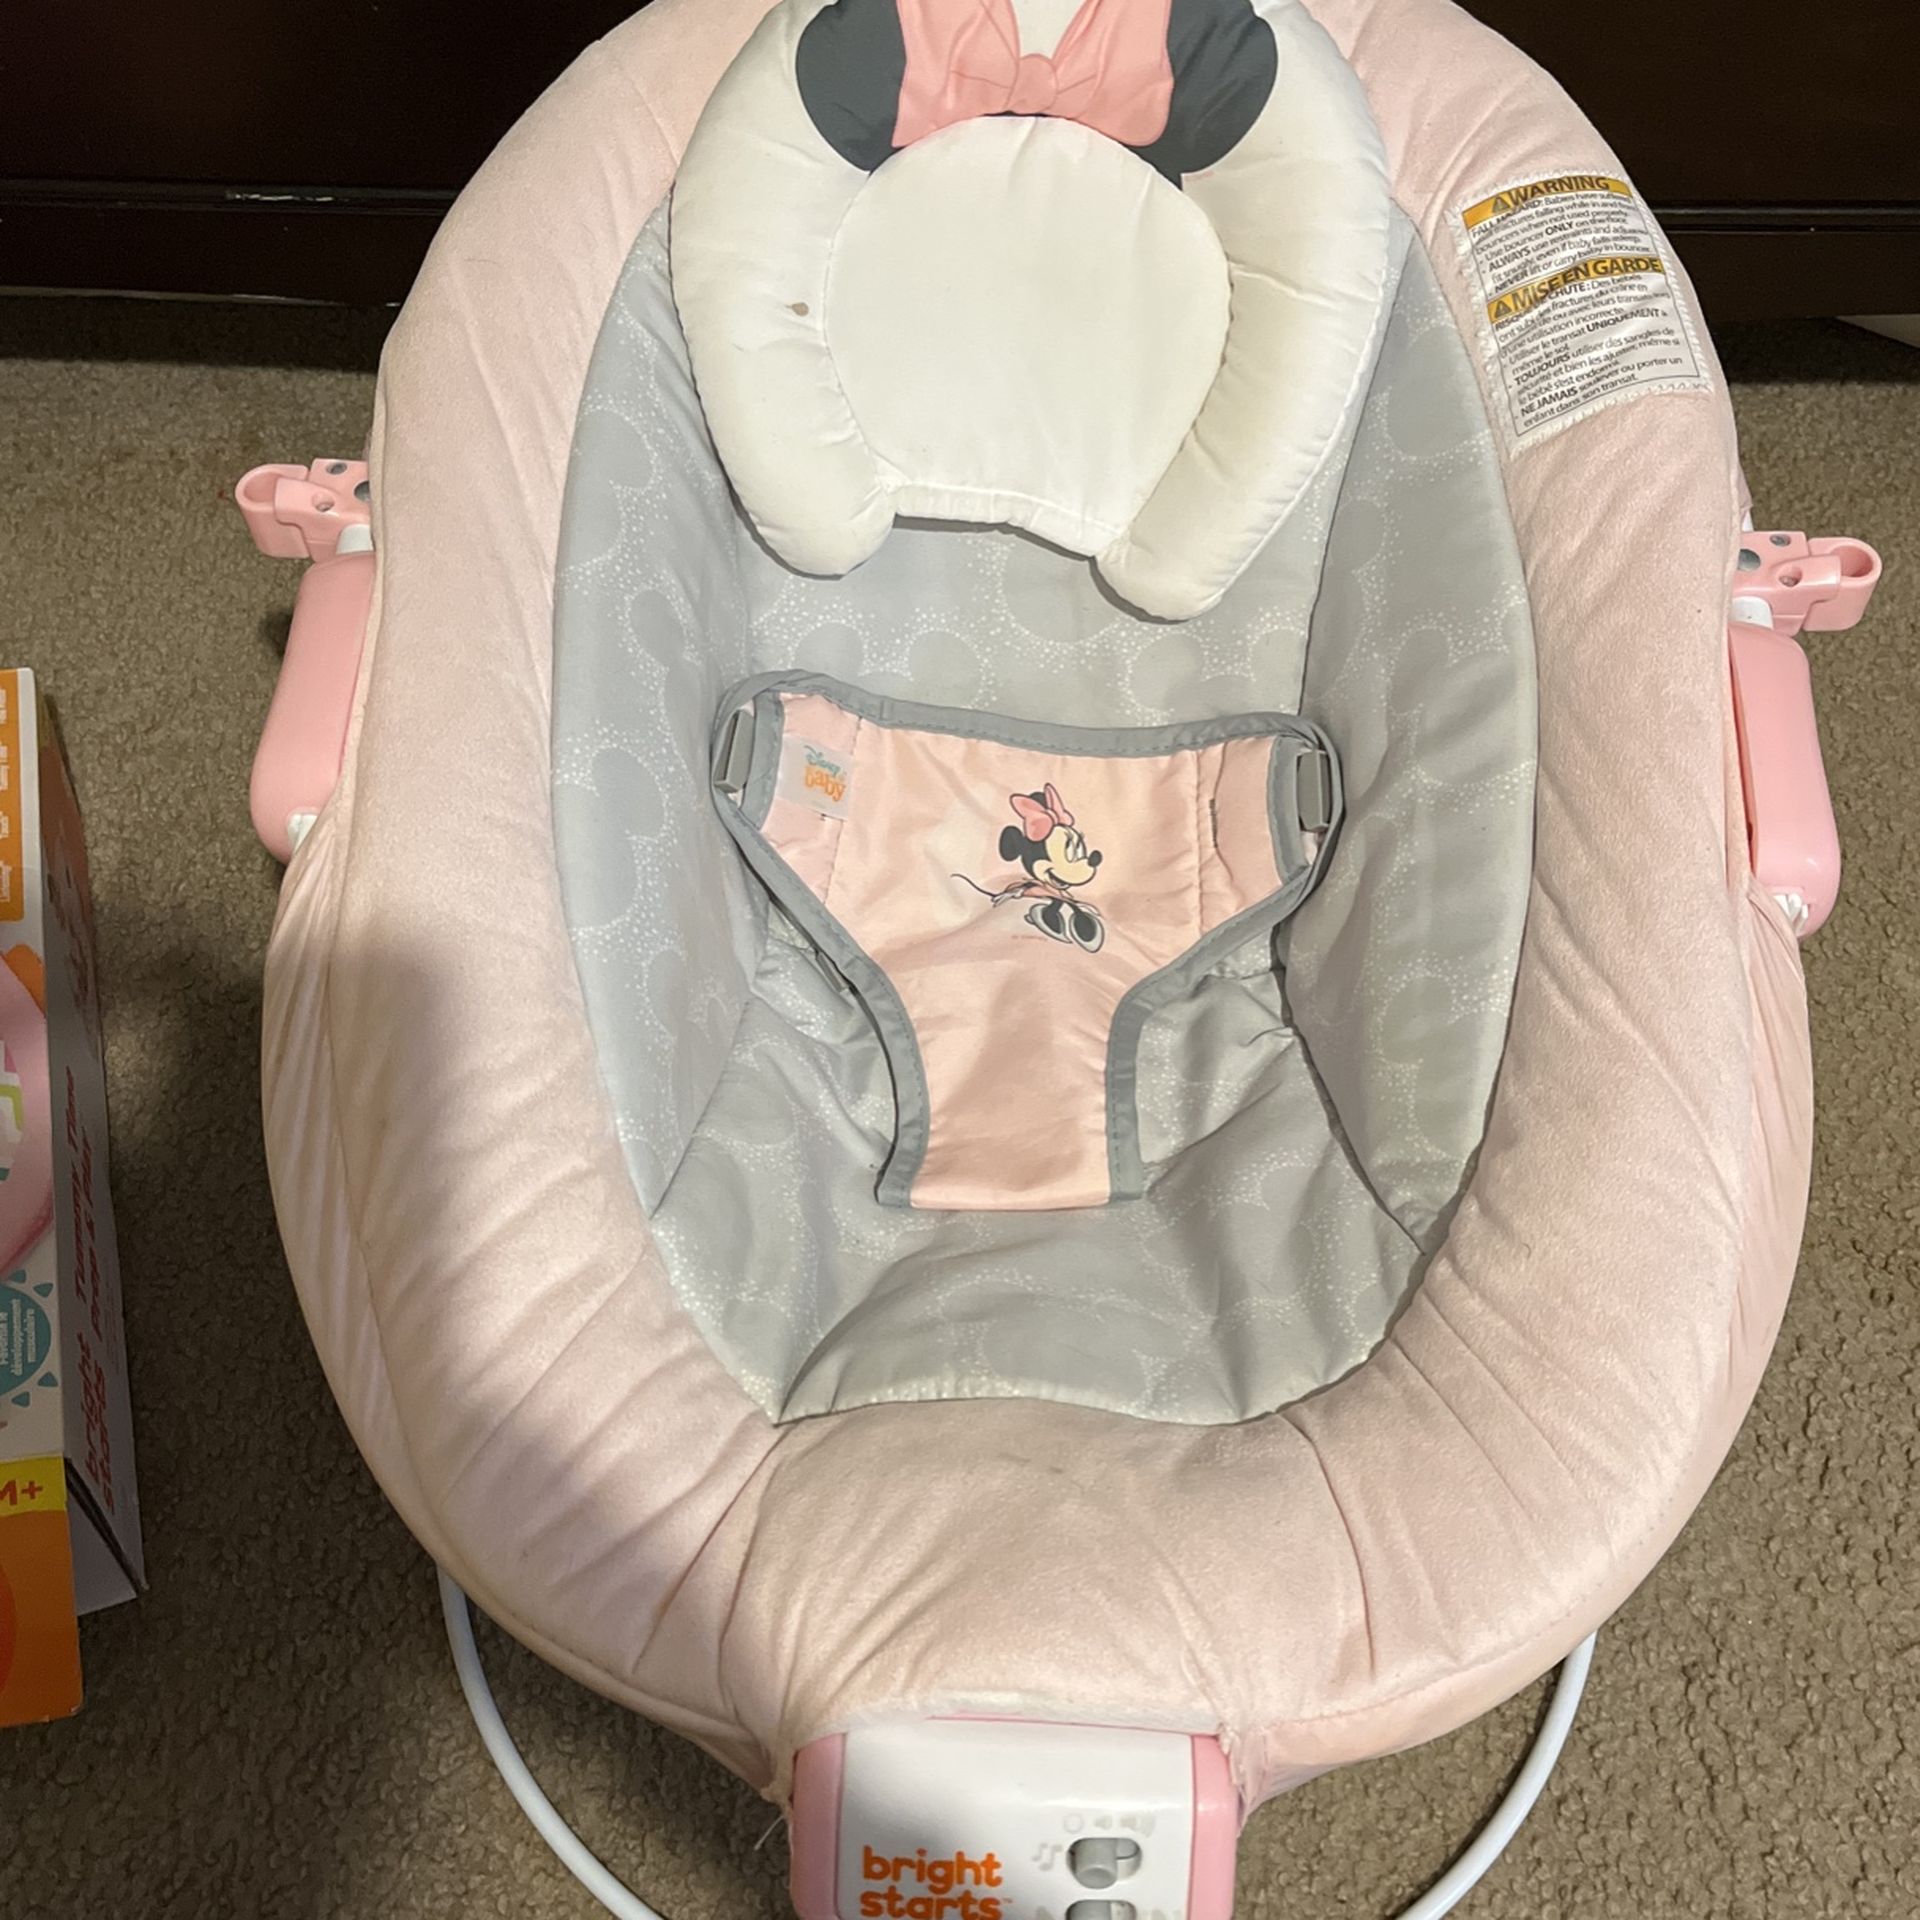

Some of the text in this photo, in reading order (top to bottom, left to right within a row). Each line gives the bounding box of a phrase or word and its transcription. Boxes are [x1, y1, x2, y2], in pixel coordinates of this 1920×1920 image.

[1508, 176, 1610, 206] WARNING
[1471, 220, 1495, 238] FALL
[1503, 231, 1544, 252] bouncer
[1545, 221, 1573, 236] ONLY
[1575, 220, 1589, 228] on
[1519, 217, 1549, 234] when
[1489, 245, 1531, 272] ALWAYS
[1531, 240, 1549, 252] use
[1536, 246, 1560, 262] even
[1567, 239, 1591, 252] baby
[1495, 268, 1528, 293] NEVER
[1553, 253, 1578, 268] carry
[1511, 274, 1561, 312] MISE
[1561, 262, 1591, 285] EN
[1593, 257, 1662, 276] GARDE
[1591, 279, 1611, 290] Des
[1551, 326, 1586, 344] transat
[1586, 307, 1660, 332] UNIQUEMENT
[1552, 311, 1567, 321] ou
[1514, 351, 1571, 385] TOUJOURS
[1564, 358, 1588, 373] bien
[1520, 402, 1536, 417] NE
[1536, 385, 1578, 410] JAMAIS
[1620, 362, 1636, 373] ou
[1636, 357, 1668, 371] porter
[1669, 356, 1683, 365] un
[1524, 407, 1556, 428] enfant
[1556, 398, 1581, 413] dans
[1582, 386, 1601, 400] son
[805, 766, 846, 801] baby
[76, 1331, 99, 1484] bright
[93, 1360, 115, 1515] starts
[863, 1844, 1003, 1895] bright
[860, 1885, 1003, 1920] starts
